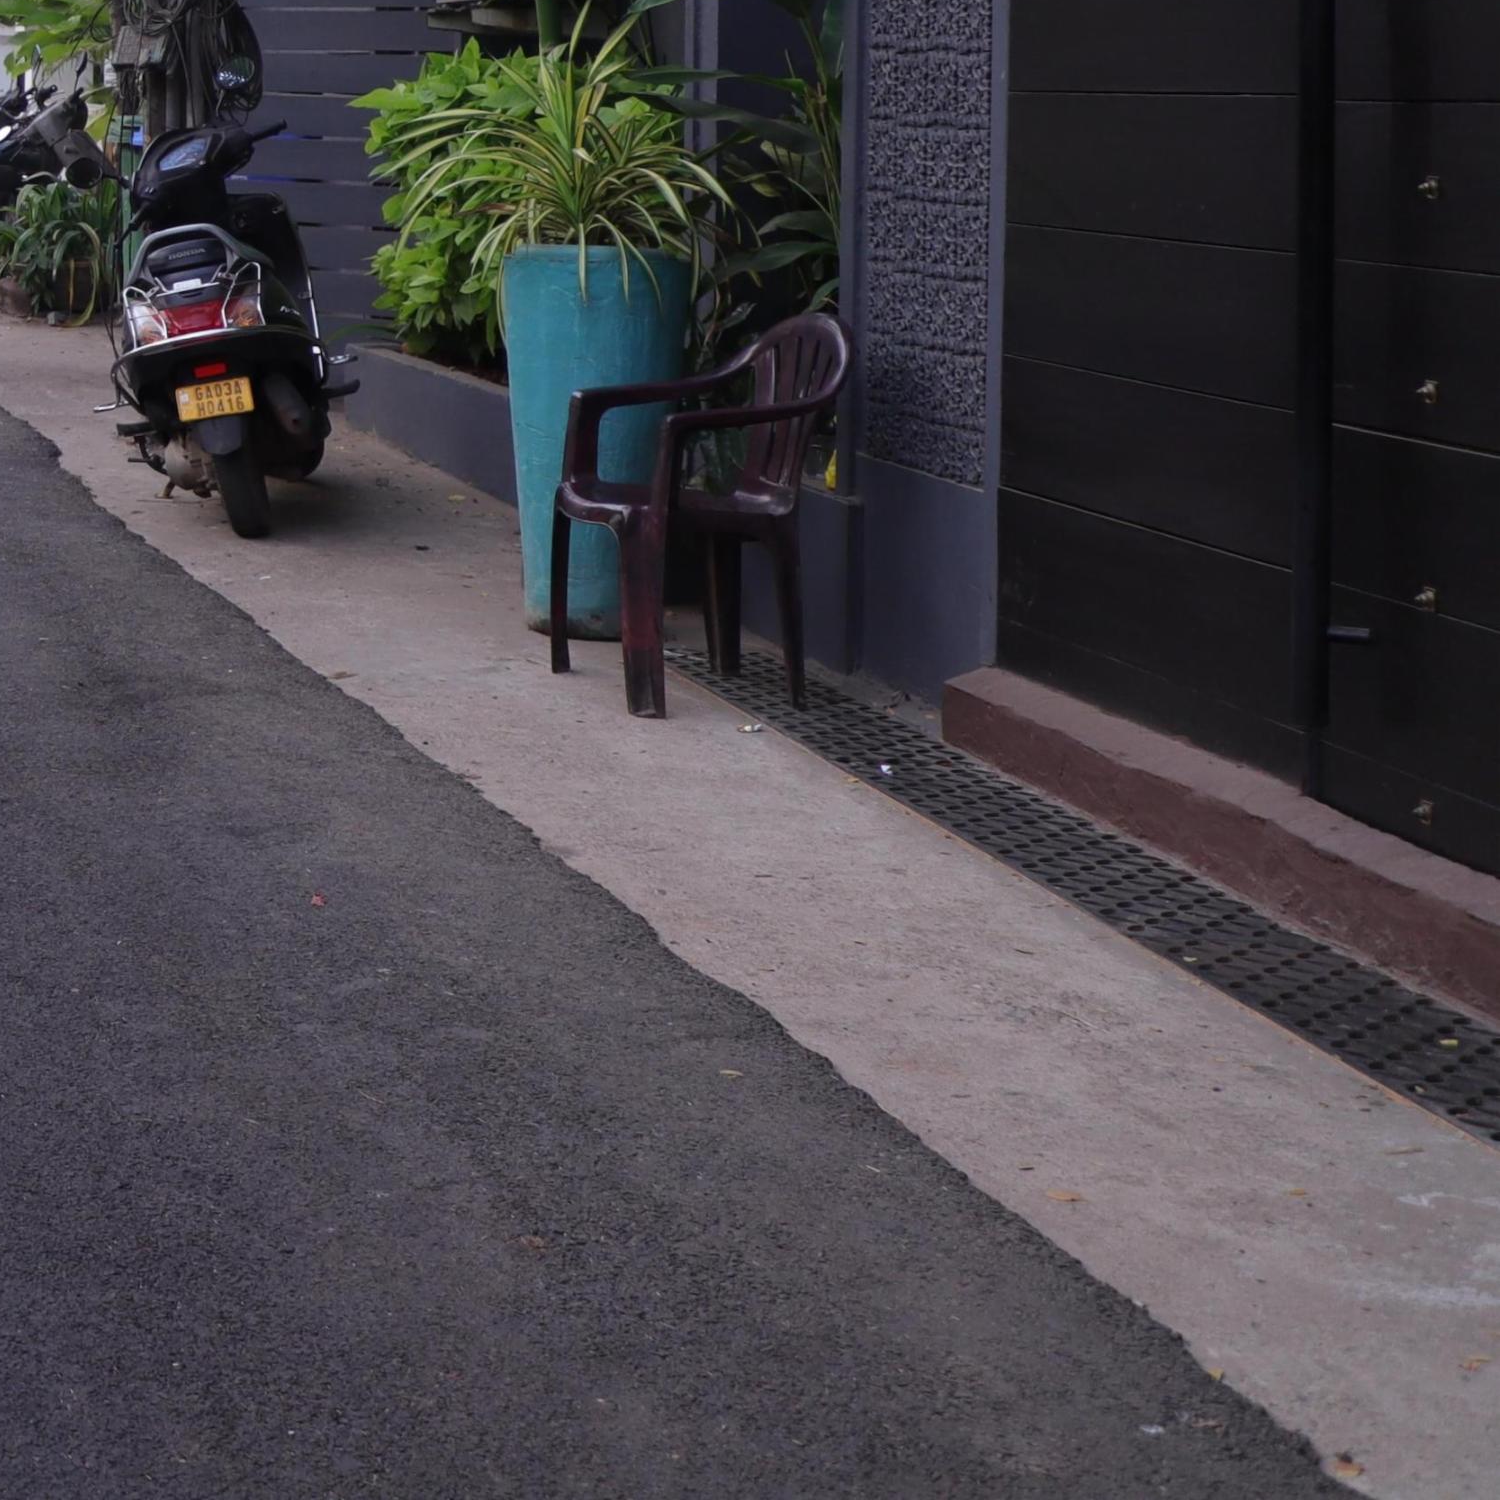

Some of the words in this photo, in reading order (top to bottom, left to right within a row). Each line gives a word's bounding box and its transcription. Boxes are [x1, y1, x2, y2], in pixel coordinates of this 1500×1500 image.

[168, 248, 206, 260] HONDA
[195, 380, 242, 401] GA03A
[197, 396, 244, 416] H0416
